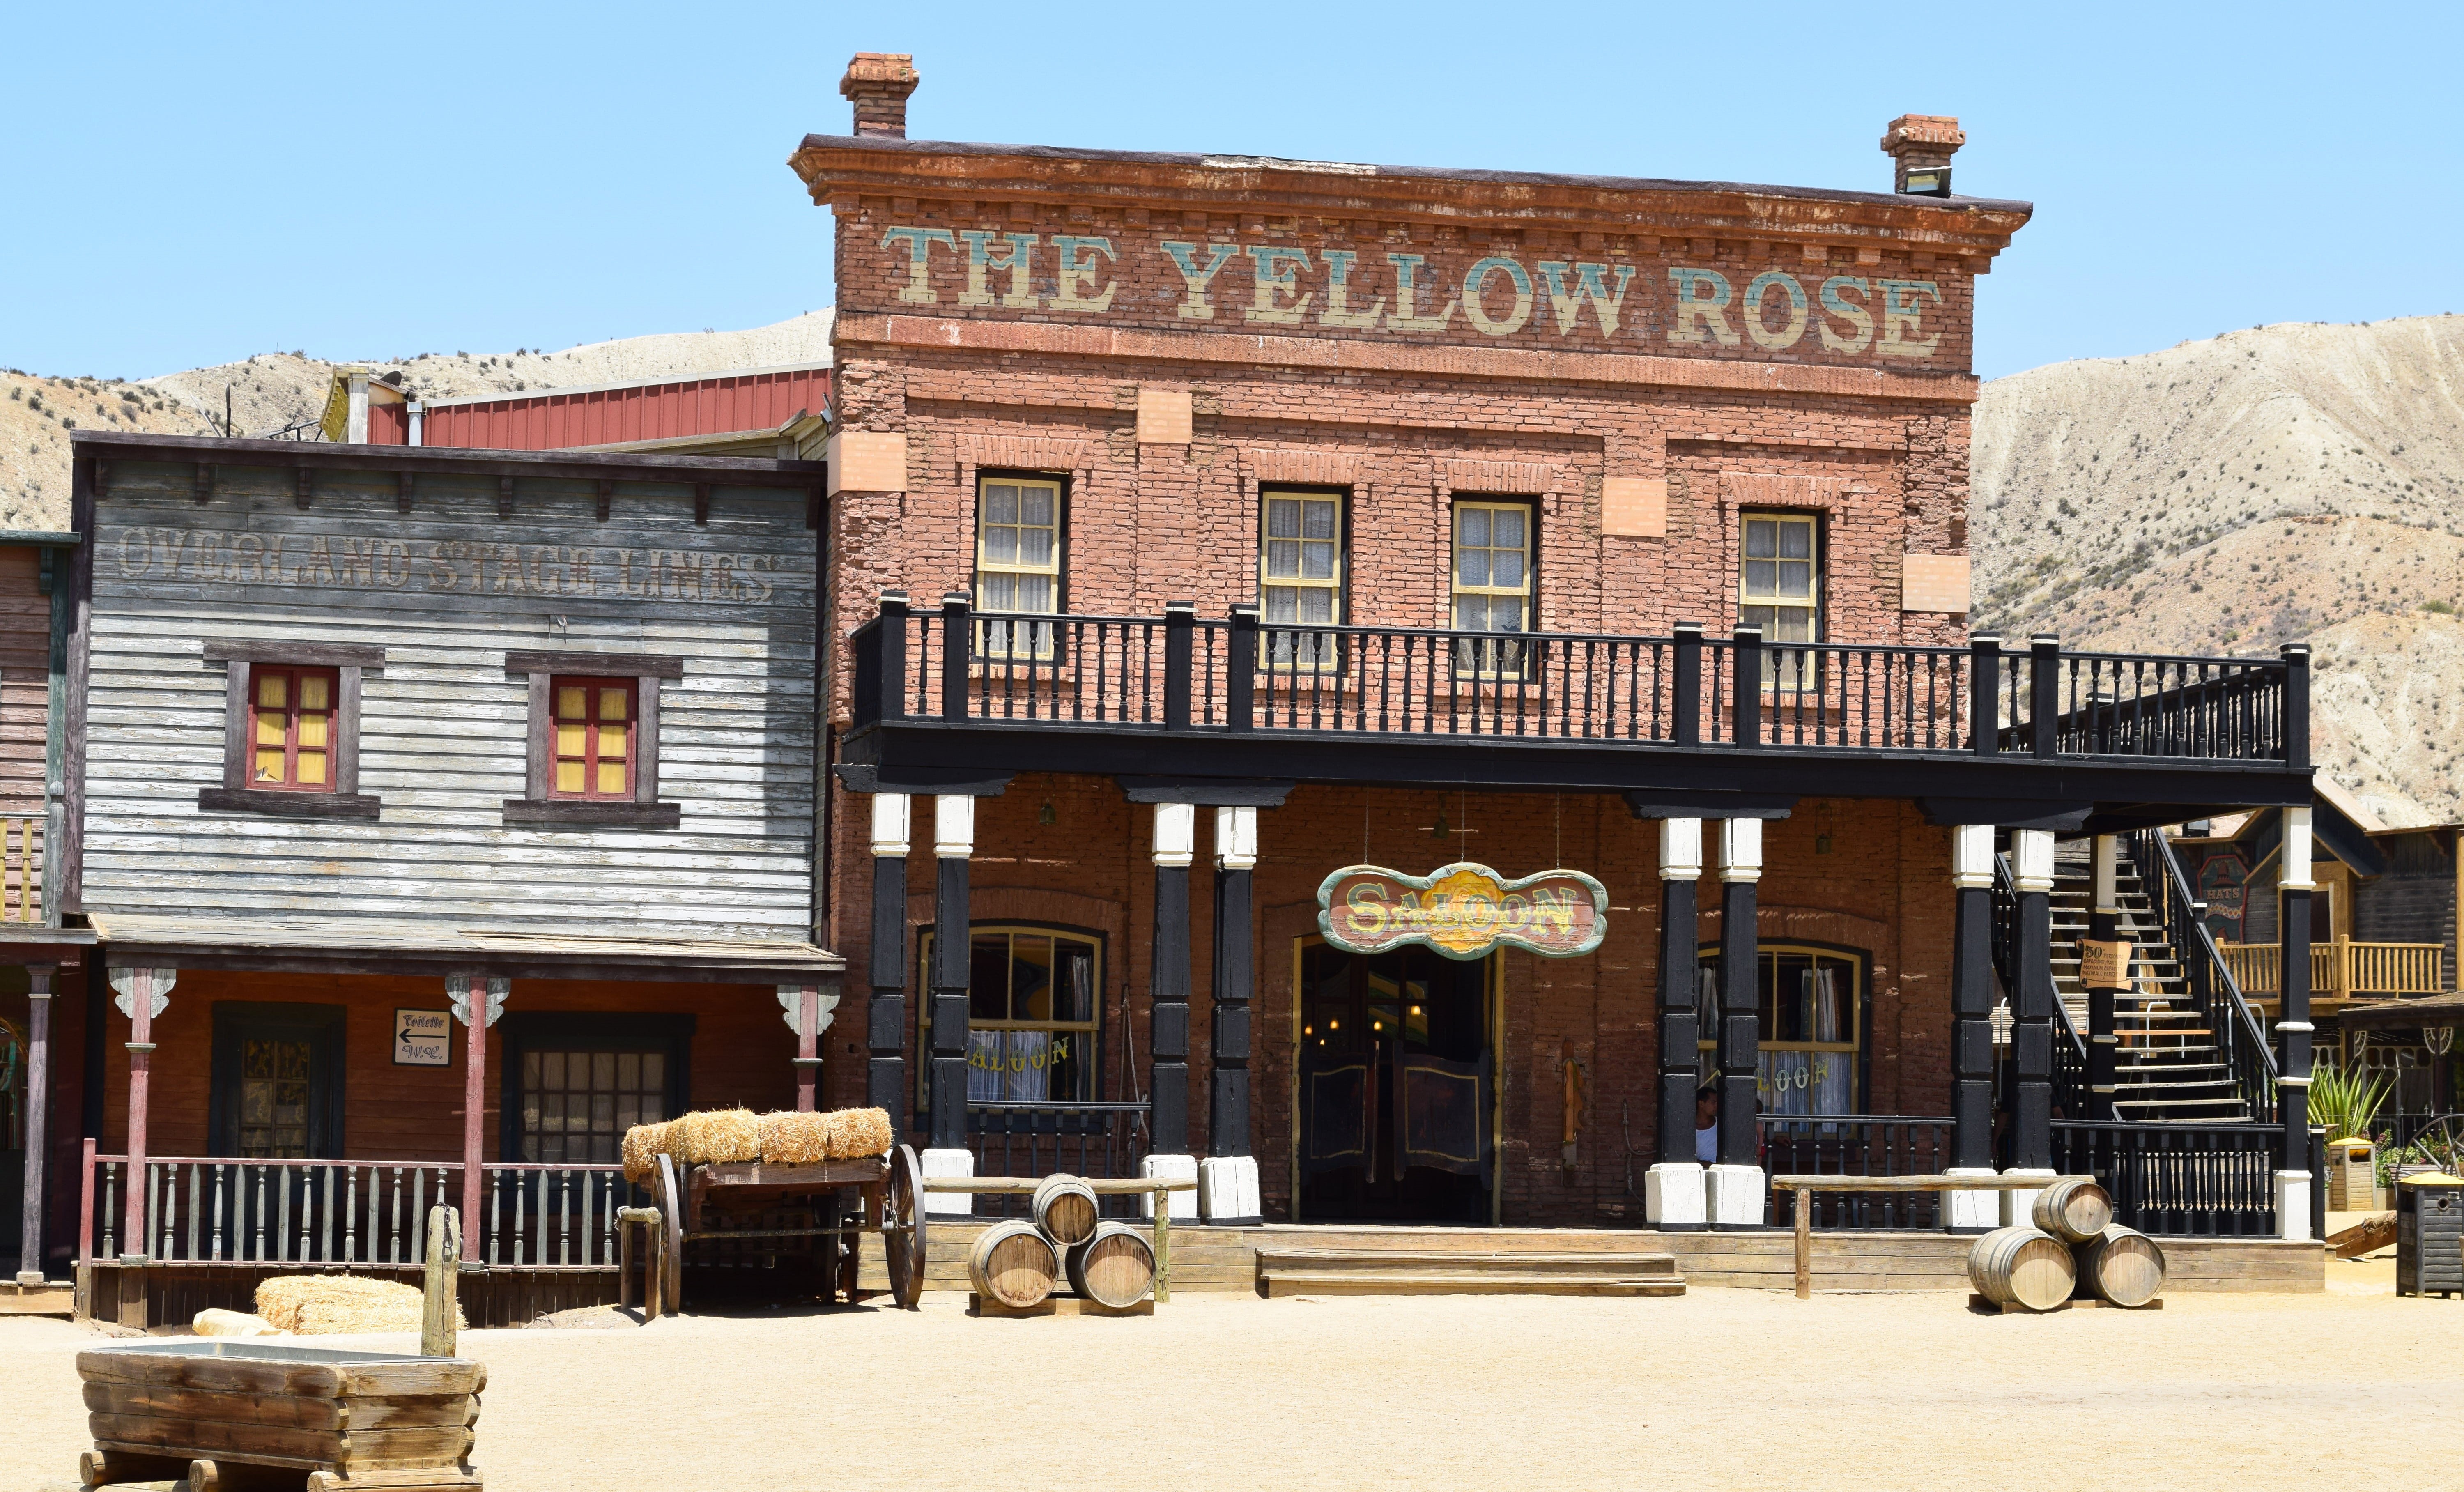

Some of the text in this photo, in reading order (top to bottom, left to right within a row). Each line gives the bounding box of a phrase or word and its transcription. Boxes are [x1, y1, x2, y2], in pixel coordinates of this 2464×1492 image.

[880, 225, 1942, 357] THE YELLOW ROSE
[118, 527, 781, 602] OVERLAND STAGE LINES
[2207, 888, 2239, 899] HATS
[2085, 945, 2102, 958] 50
[402, 1014, 444, 1028] Toilette
[402, 1044, 443, 1059] W.C.
[968, 1036, 1069, 1072] ALOON
[1754, 1058, 1829, 1092] LOON
